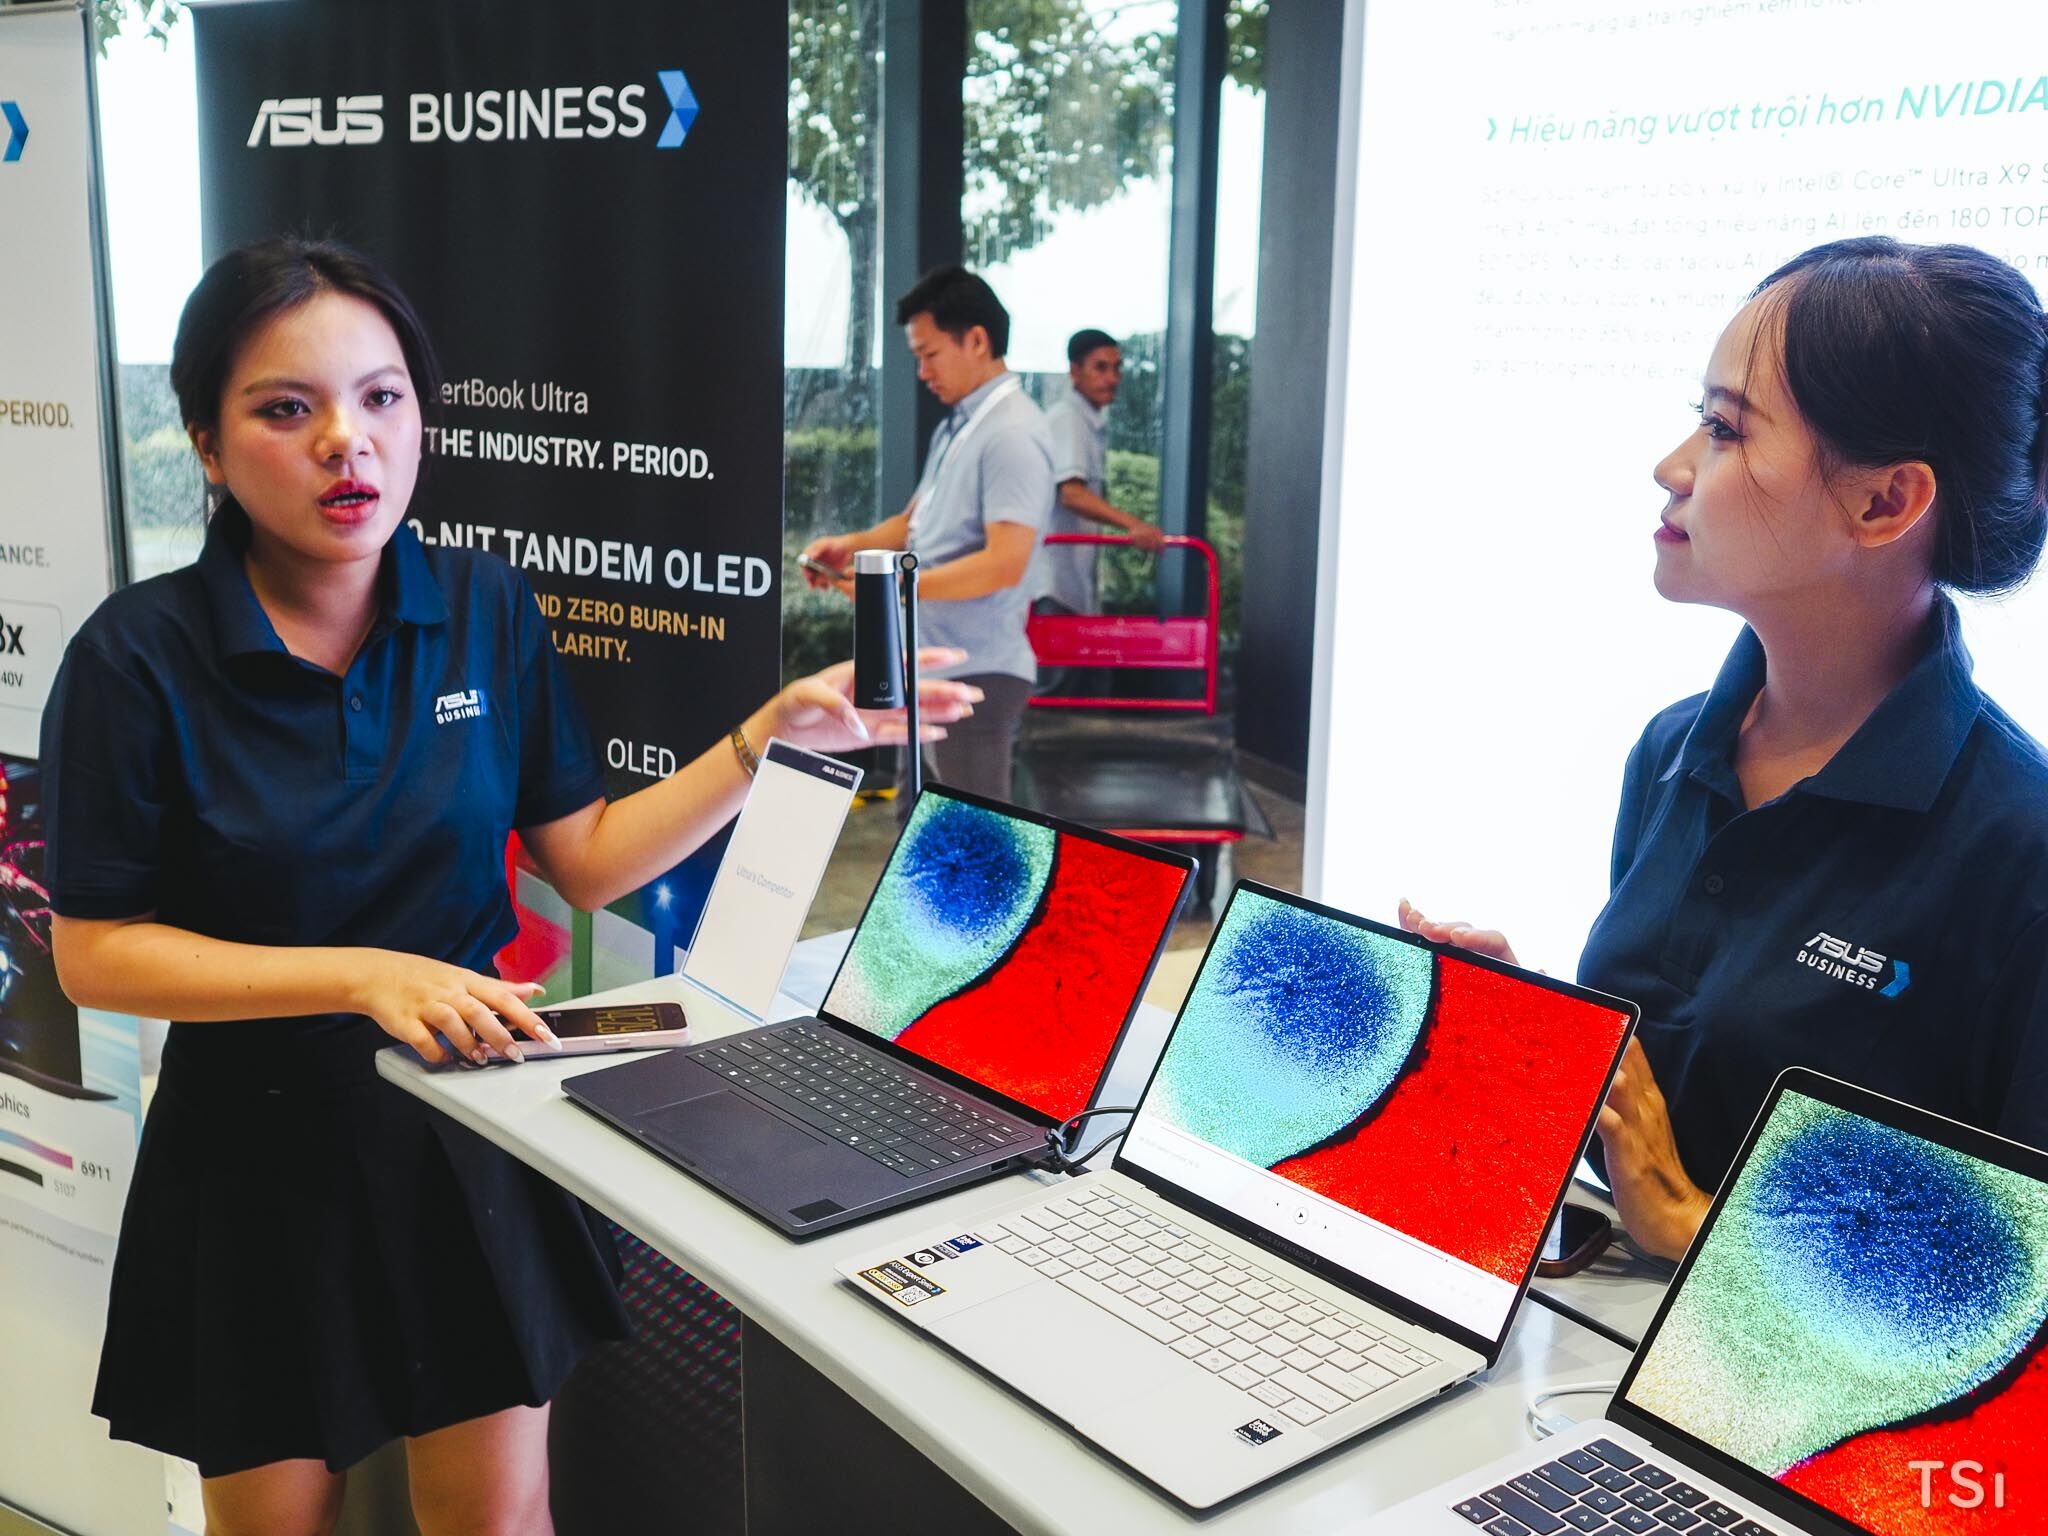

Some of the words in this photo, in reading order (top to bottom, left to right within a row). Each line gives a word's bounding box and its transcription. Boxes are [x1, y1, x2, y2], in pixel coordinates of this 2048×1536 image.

[246, 94, 384, 148] ASUS
[409, 84, 647, 142] BUSINESS
[1582, 107, 1656, 144] năng
[1665, 103, 1741, 142] vượt
[1750, 95, 1807, 139] trội
[1815, 93, 1884, 126] hơn
[1894, 76, 2048, 120] NVIDIA
[1853, 167, 1922, 191] Core™
[1933, 166, 1988, 188] Ultra
[1998, 162, 2031, 185] X9
[1952, 207, 1991, 228] 180
[441, 378, 524, 411] ertBook
[531, 380, 589, 415] Ultra
[424, 426, 473, 458] THE
[479, 430, 604, 470] INDUSTRY.
[613, 442, 715, 480] PERIOD.
[503, 528, 653, 585] TANDEM
[664, 550, 773, 598] OLED
[567, 597, 624, 627] ZERO
[630, 605, 726, 641] BURN-IN
[607, 737, 677, 780] OLED
[1796, 949, 1878, 990] BUSINESS
[1805, 931, 1887, 974] ASUS
[81, 1160, 111, 1182] 6911
[1578, 1514, 1589, 1522] A
[1597, 1497, 1608, 1505] Q
[1629, 1515, 1643, 1524] W
